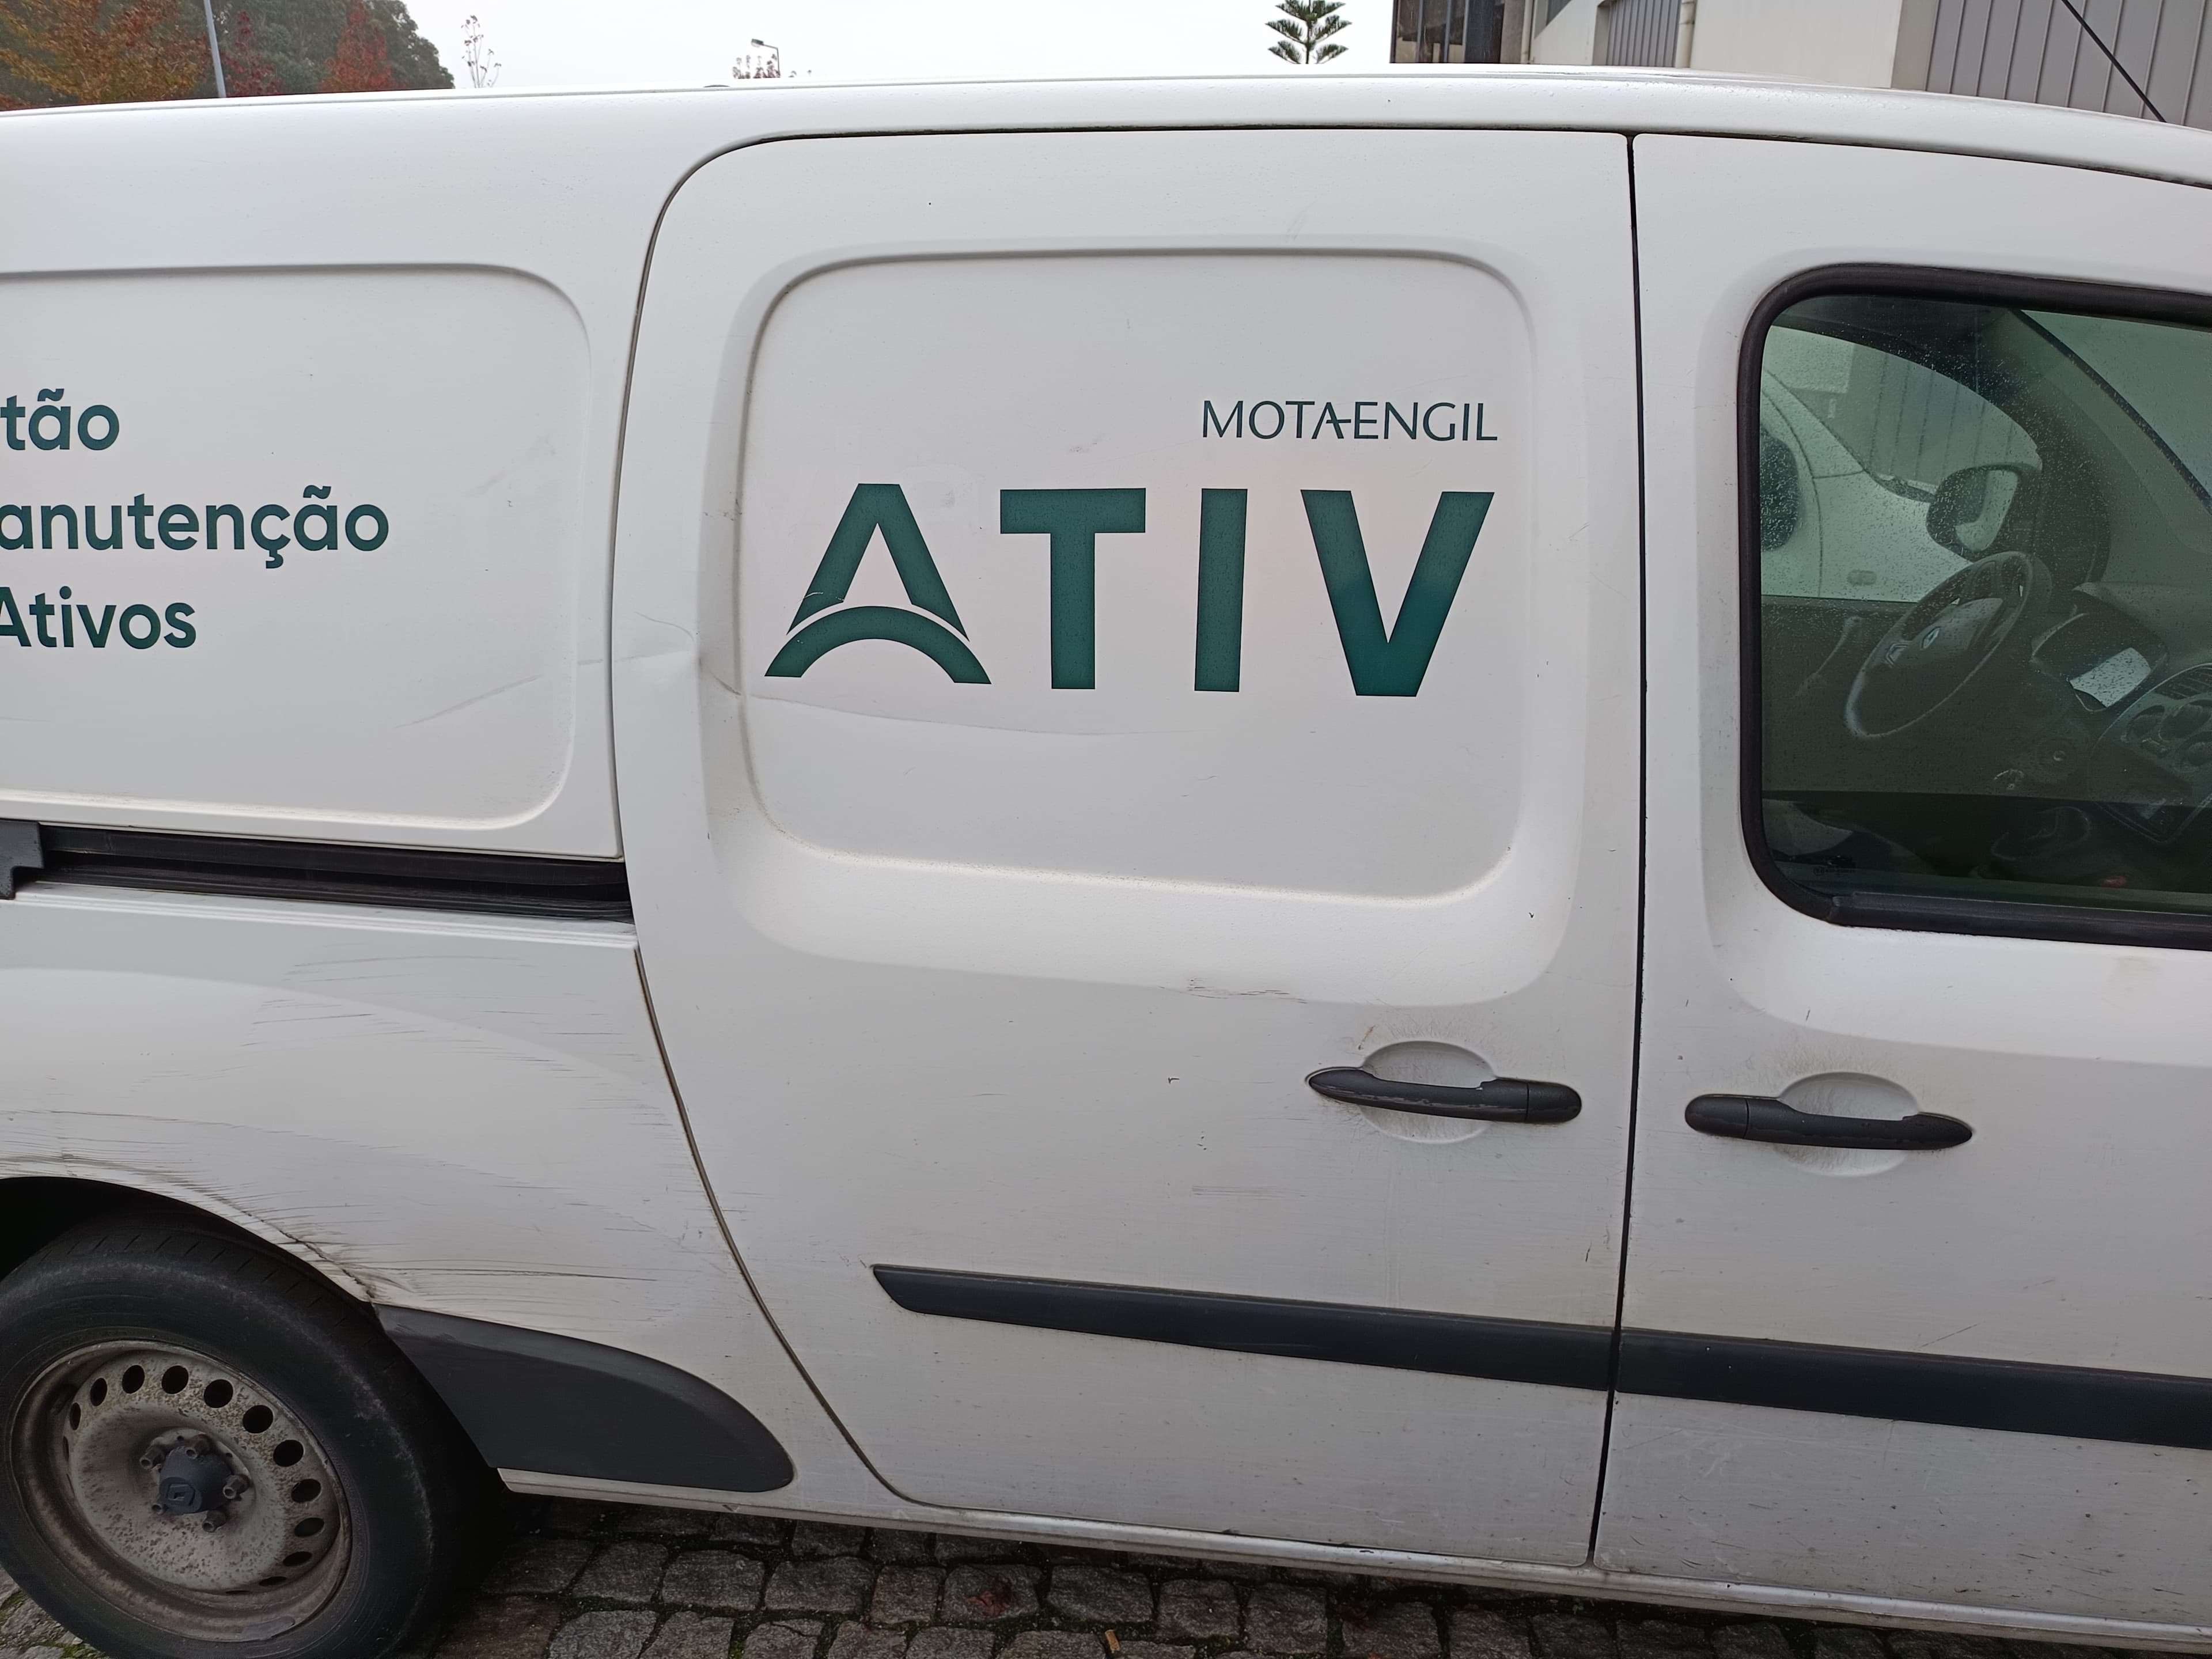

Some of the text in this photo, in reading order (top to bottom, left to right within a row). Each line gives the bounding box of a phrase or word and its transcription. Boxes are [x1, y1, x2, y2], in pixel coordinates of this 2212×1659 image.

[0, 484, 389, 570] anutenção
[0, 585, 197, 650] Ativos
[763, 483, 1495, 698] ATIV
